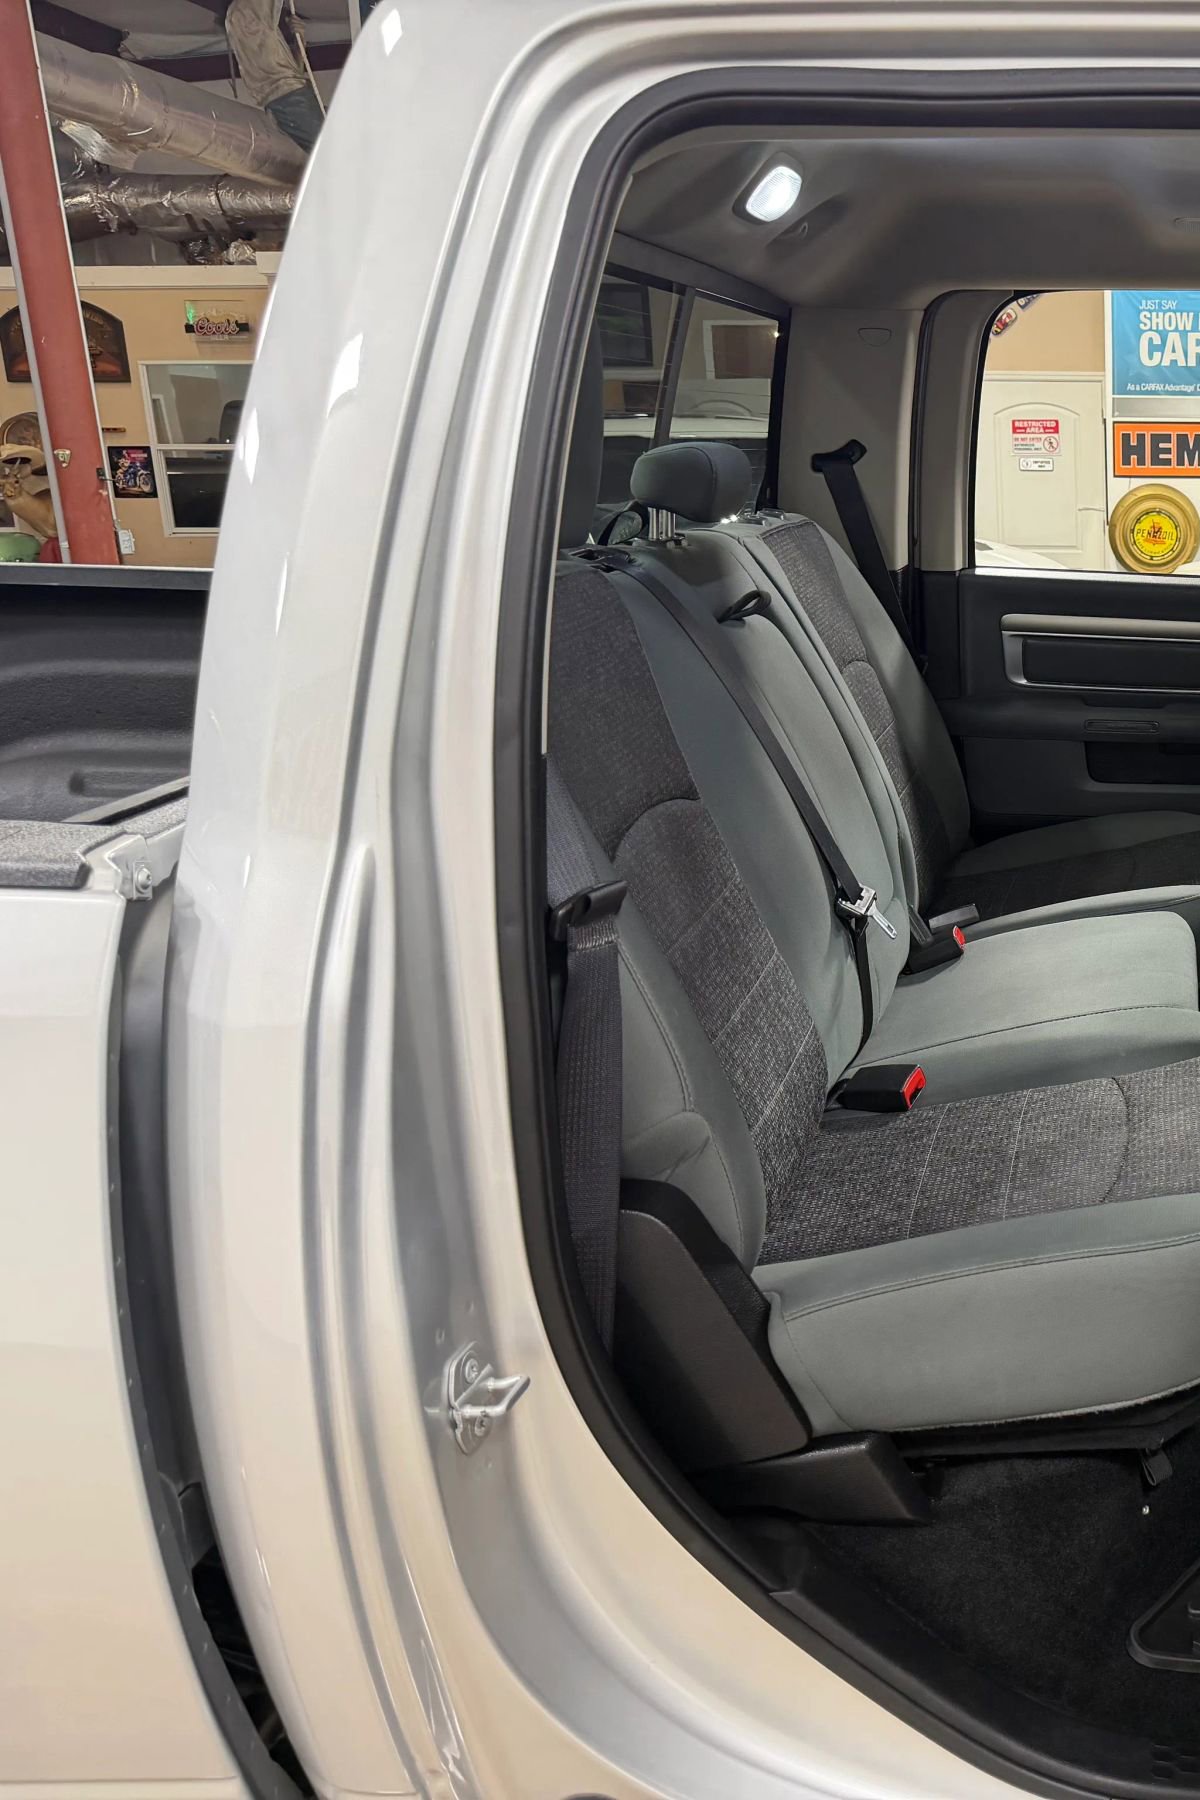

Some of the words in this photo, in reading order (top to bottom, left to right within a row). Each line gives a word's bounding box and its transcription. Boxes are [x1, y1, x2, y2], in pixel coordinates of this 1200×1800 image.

[1139, 300, 1159, 310] JUST
[1161, 300, 1177, 310] SAY
[194, 317, 240, 335] Coors
[1139, 311, 1194, 331] SHOW
